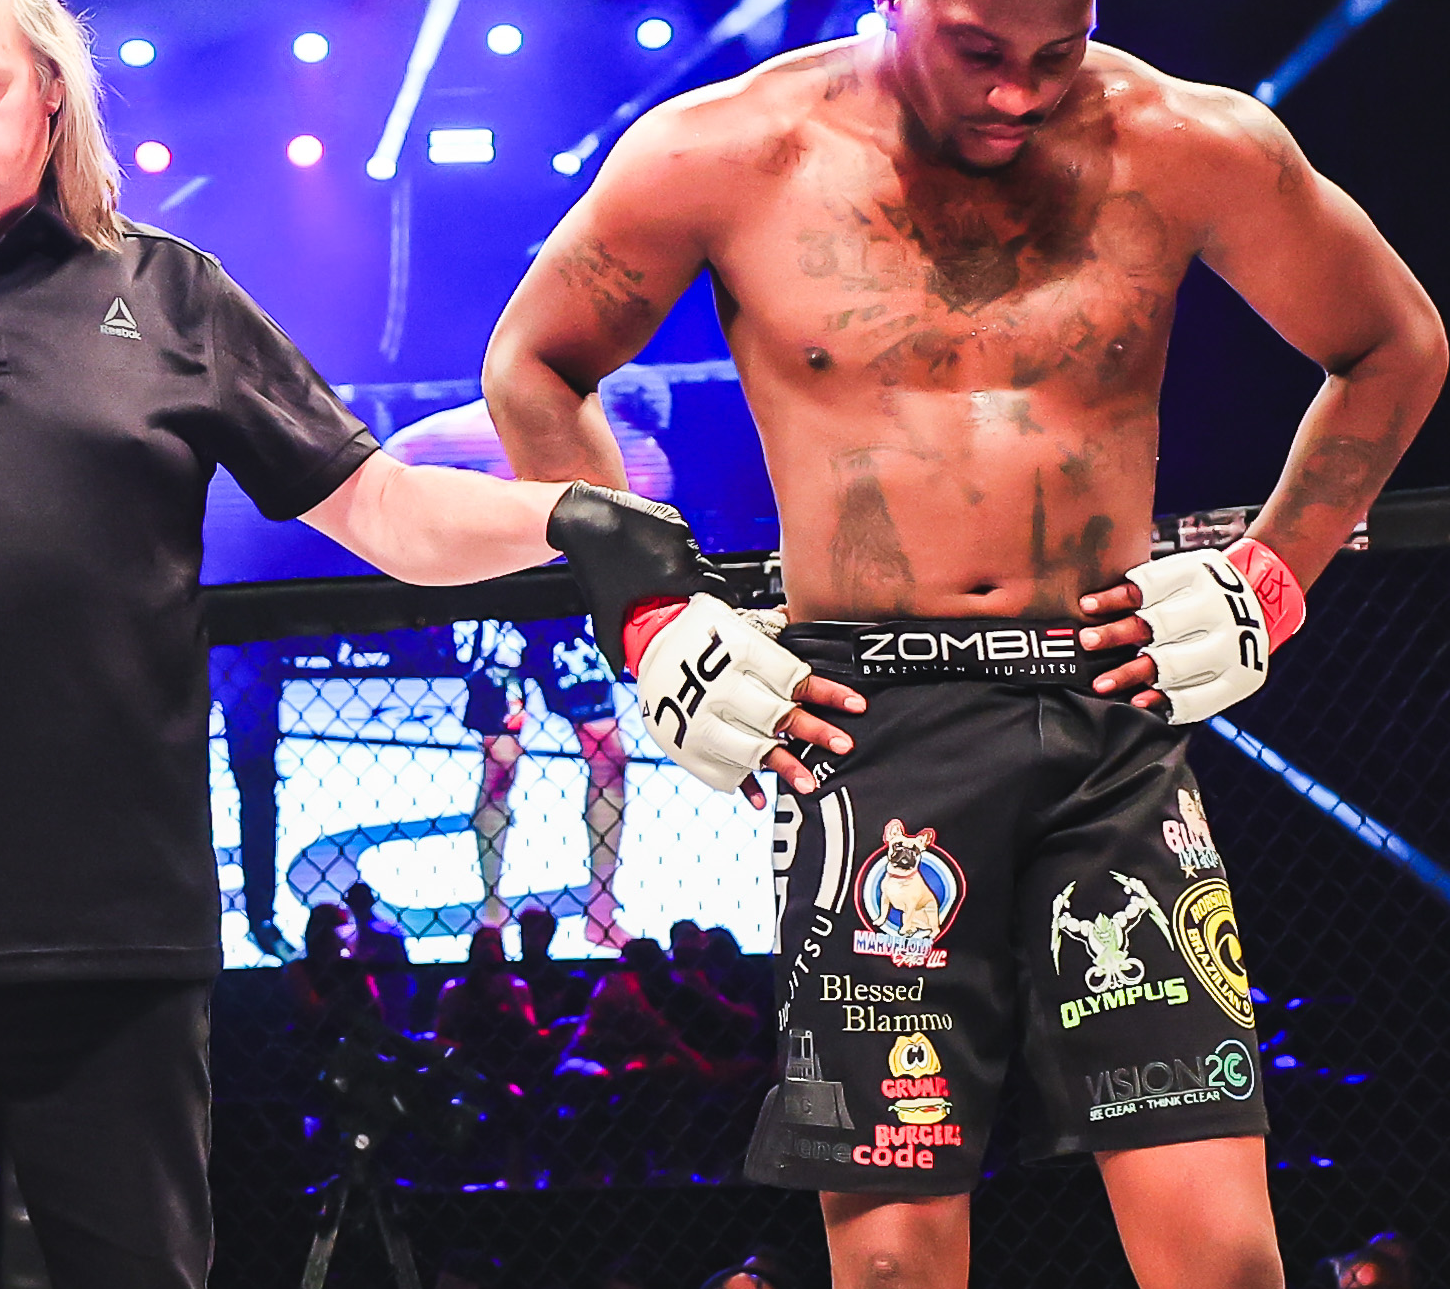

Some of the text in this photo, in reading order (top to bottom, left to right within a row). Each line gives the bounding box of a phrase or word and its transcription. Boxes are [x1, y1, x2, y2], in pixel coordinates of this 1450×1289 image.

[1203, 562, 1263, 672] PFC
[860, 629, 1075, 661] ZOMBIE
[654, 625, 732, 749] PFC
[819, 974, 925, 1002] Blessed
[1186, 927, 1242, 1012] BRAZILIAN
[841, 1004, 954, 1033] Blammo
[1060, 977, 1190, 1029] OLYMPUS
[1147, 1096, 1182, 1110] THINK
[1183, 1090, 1221, 1104] CLEAR
